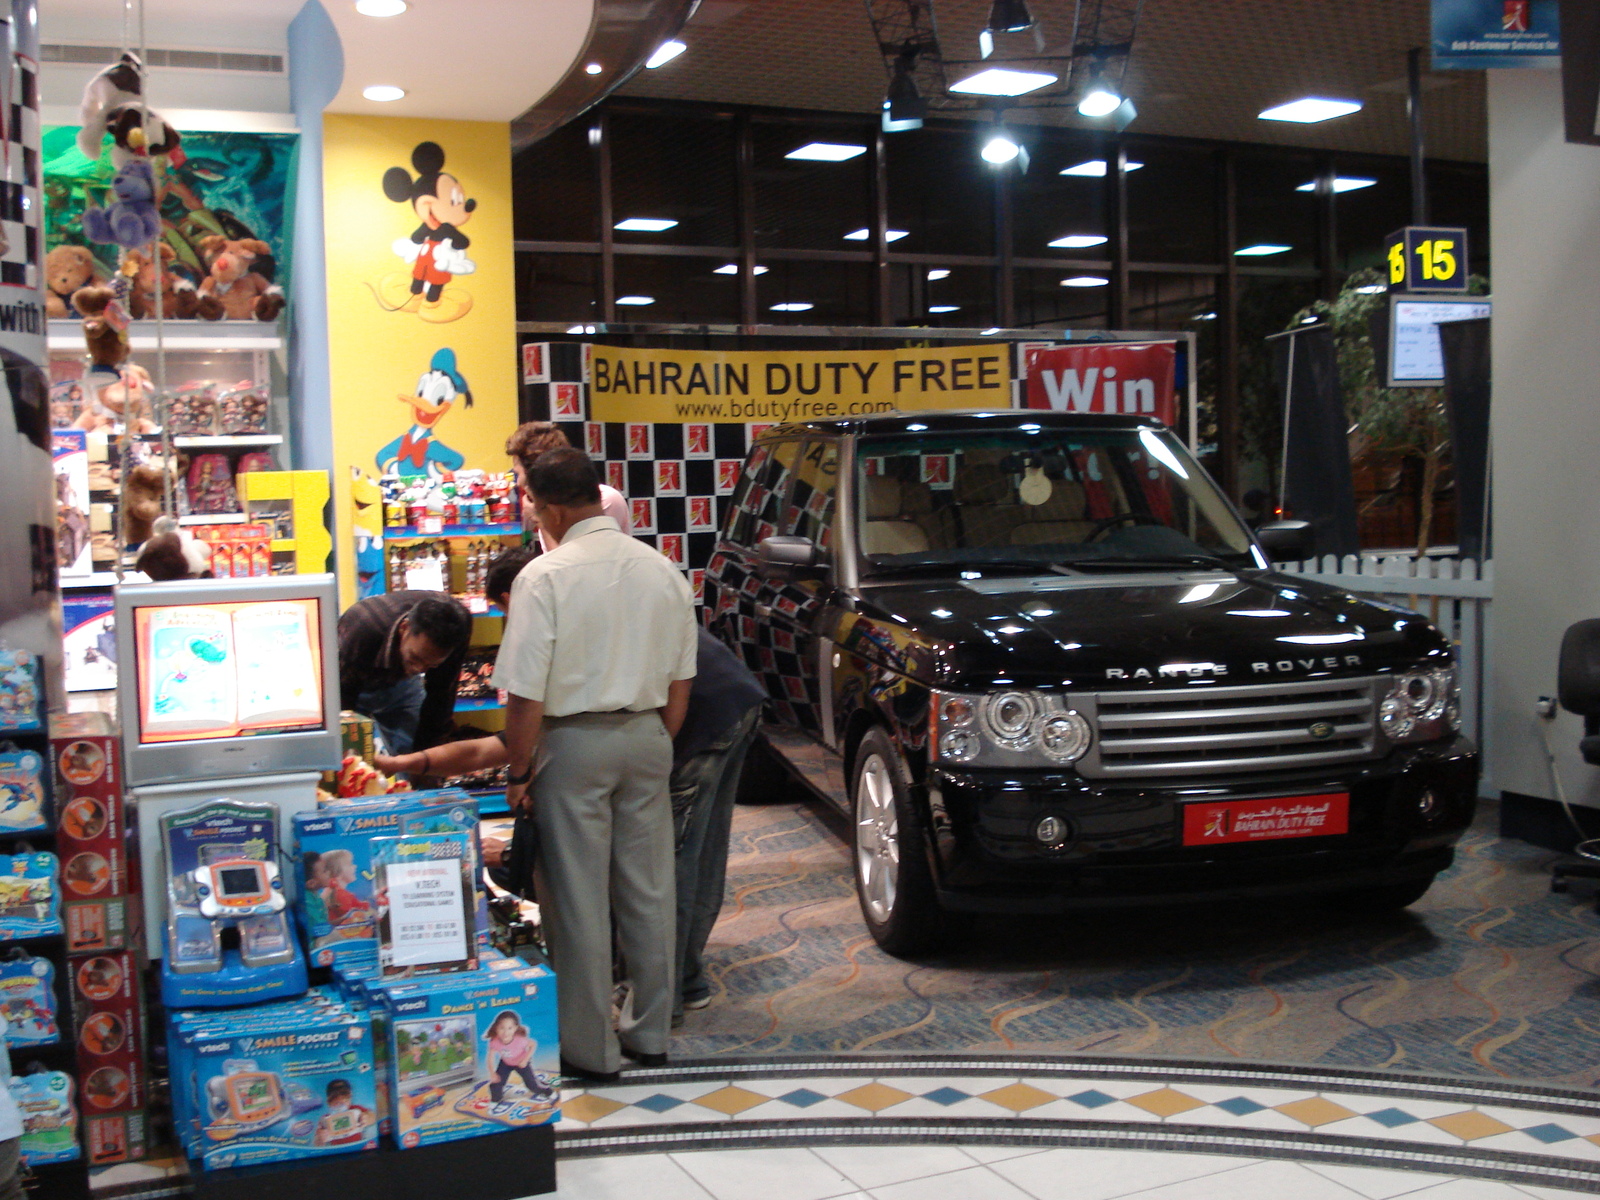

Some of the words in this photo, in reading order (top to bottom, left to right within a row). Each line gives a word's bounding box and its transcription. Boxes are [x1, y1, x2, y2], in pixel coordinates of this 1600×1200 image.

[1387, 242, 1405, 285] 15
[1415, 239, 1457, 281] 15
[0, 300, 40, 335] with
[594, 357, 749, 396] BAHRAIN
[765, 361, 879, 396] DUTY
[893, 355, 1001, 393] FREE
[1040, 365, 1156, 414] Win
[675, 398, 896, 421] www.bdutyfree.com
[1105, 663, 1229, 679] RANGE
[1251, 655, 1362, 674] ROVER
[302, 820, 334, 833] vtech
[337, 813, 399, 833] V.SMILE
[1234, 818, 1277, 833] BAHRAIN
[1277, 816, 1304, 829] DUTY
[1304, 814, 1327, 827] FREE
[396, 1001, 427, 1013] vtech
[490, 995, 522, 1008] LEARN
[198, 1041, 231, 1053] vtech
[238, 1034, 297, 1052] V.SMILE
[296, 1030, 342, 1045] POCKET
